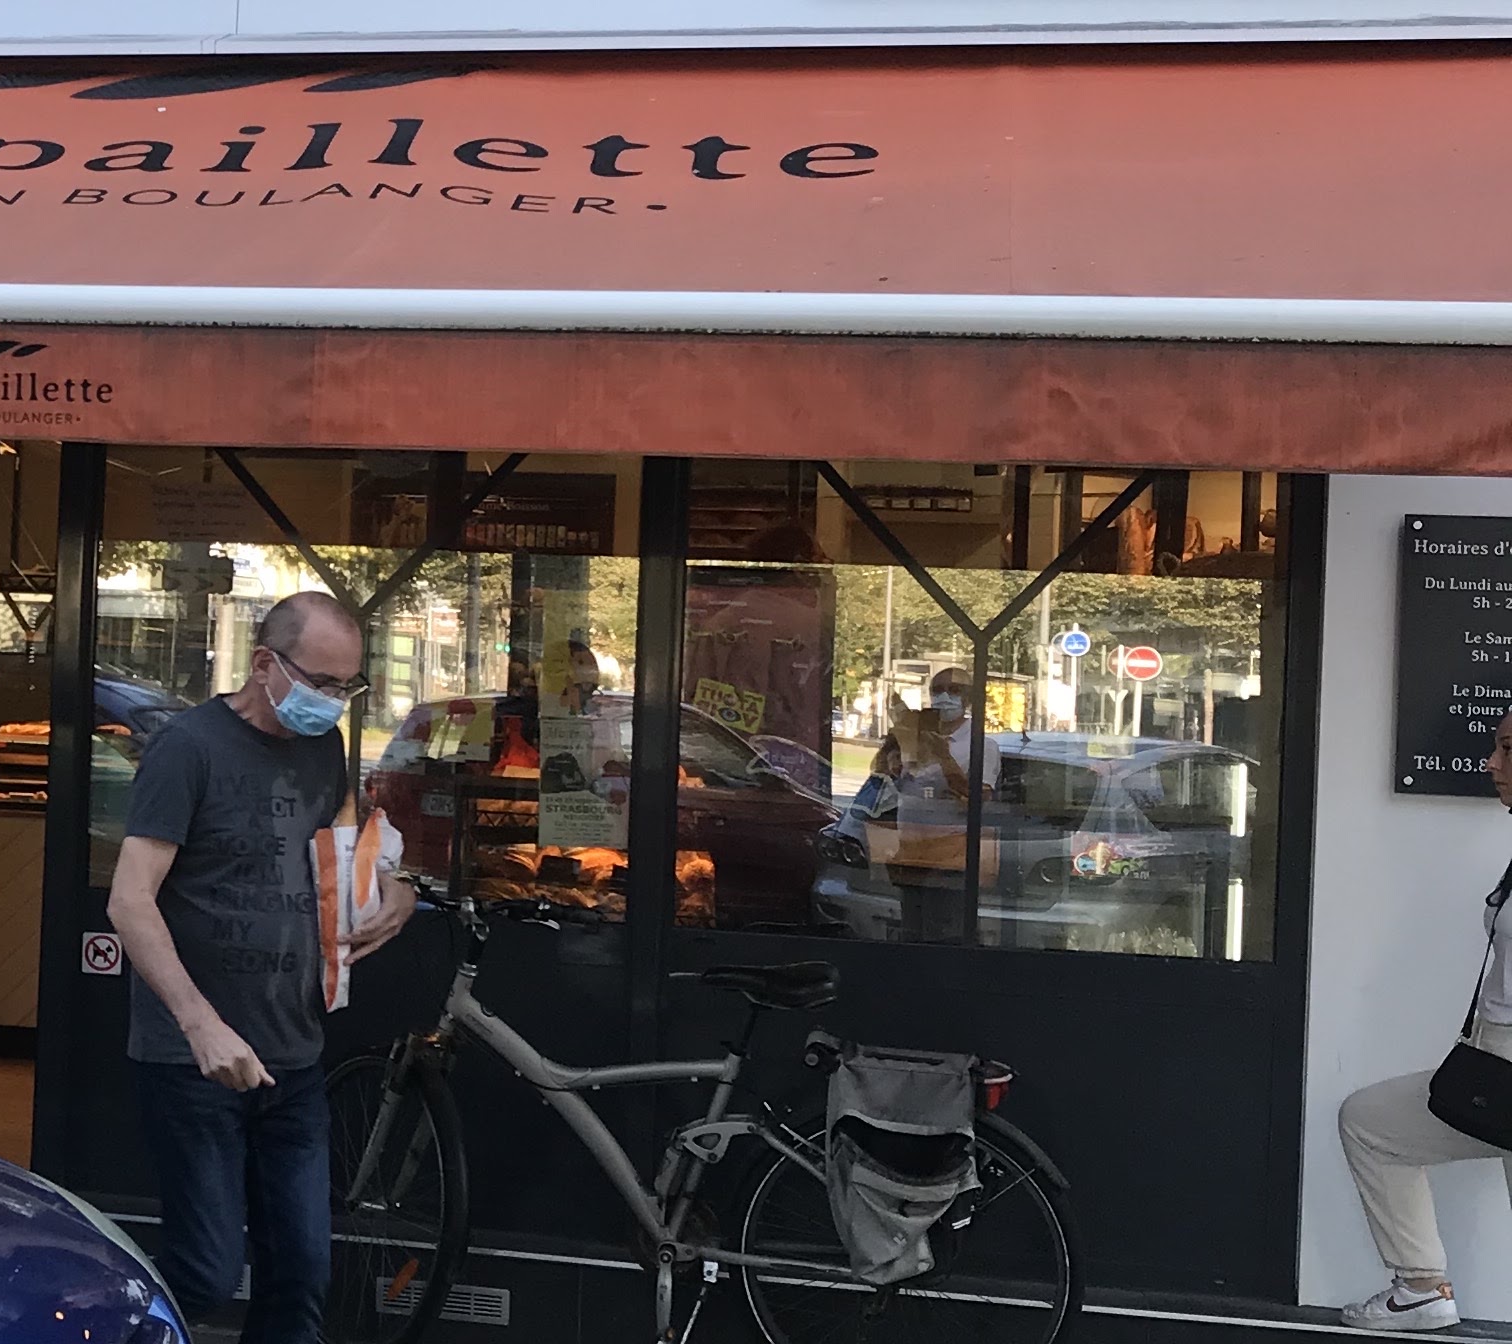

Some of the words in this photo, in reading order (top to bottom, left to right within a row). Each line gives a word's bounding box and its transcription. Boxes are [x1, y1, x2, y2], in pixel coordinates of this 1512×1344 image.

[63, 178, 624, 215] BOULANGER
[1414, 539, 1488, 555] Horaires
[1425, 577, 1445, 590] Du
[1449, 577, 1492, 591] Lundi
[1472, 596, 1490, 609] 5h
[1464, 632, 1482, 645] Le
[1471, 649, 1488, 662] 5h
[1453, 684, 1470, 697] Le
[1474, 684, 1512, 698] Dima
[1449, 703, 1463, 715] et
[1467, 703, 1504, 717] jours
[1468, 721, 1486, 734] 6h
[1414, 755, 1446, 771] Tél.
